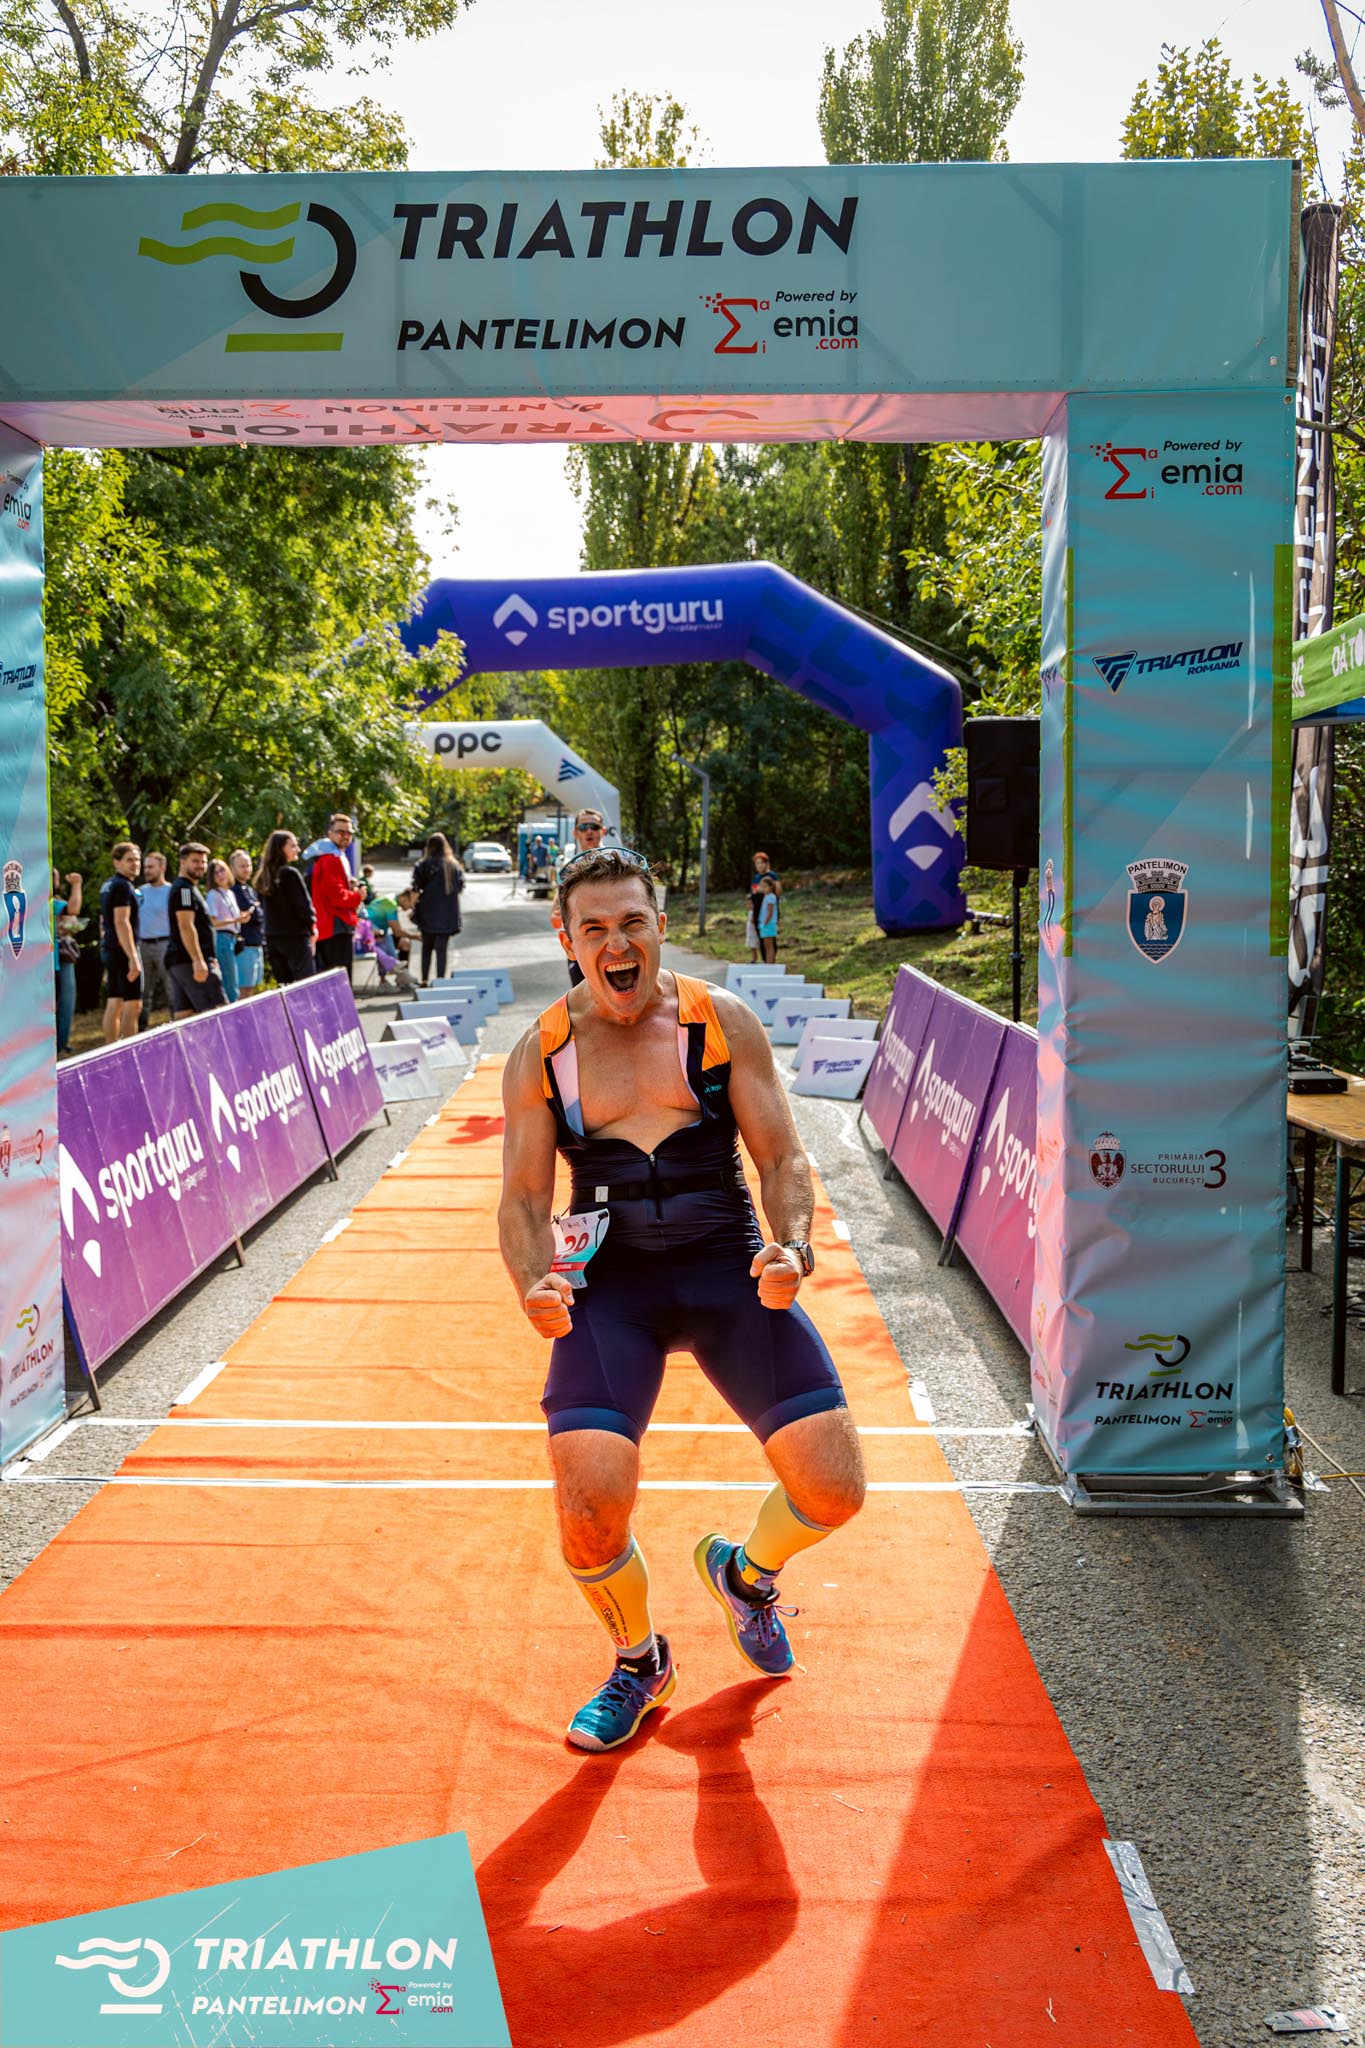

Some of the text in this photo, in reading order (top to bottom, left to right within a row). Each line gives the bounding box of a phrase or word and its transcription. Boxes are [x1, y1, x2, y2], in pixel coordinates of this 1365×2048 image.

[393, 195, 859, 261] TRIATHLON
[775, 290, 858, 304] Powered by
[396, 316, 686, 352] PANTELIMON
[773, 309, 858, 338] emia
[815, 337, 858, 350] .com
[188, 422, 615, 438] TRIATHLON
[1163, 440, 1243, 452] Powered by
[1160, 457, 1244, 485] emia
[1201, 483, 1243, 496] .com
[4, 493, 31, 521] emia
[548, 599, 723, 635] sportguru
[1135, 642, 1243, 674] TRIATLON
[1187, 659, 1241, 676] ROMANIA
[434, 731, 502, 758] ppc
[1127, 860, 1188, 875] PANTELIMON
[321, 1027, 367, 1085] sportguru
[234, 1063, 303, 1140] sportguru
[925, 1072, 977, 1146] sportguru
[98, 1118, 205, 1229] sportguru
[1130, 1149, 1227, 1189] SECTORULUI 3
[1096, 1382, 1234, 1401] TRIATHLON
[1094, 1414, 1181, 1426] PANTELIMON
[1207, 1414, 1232, 1424] emia
